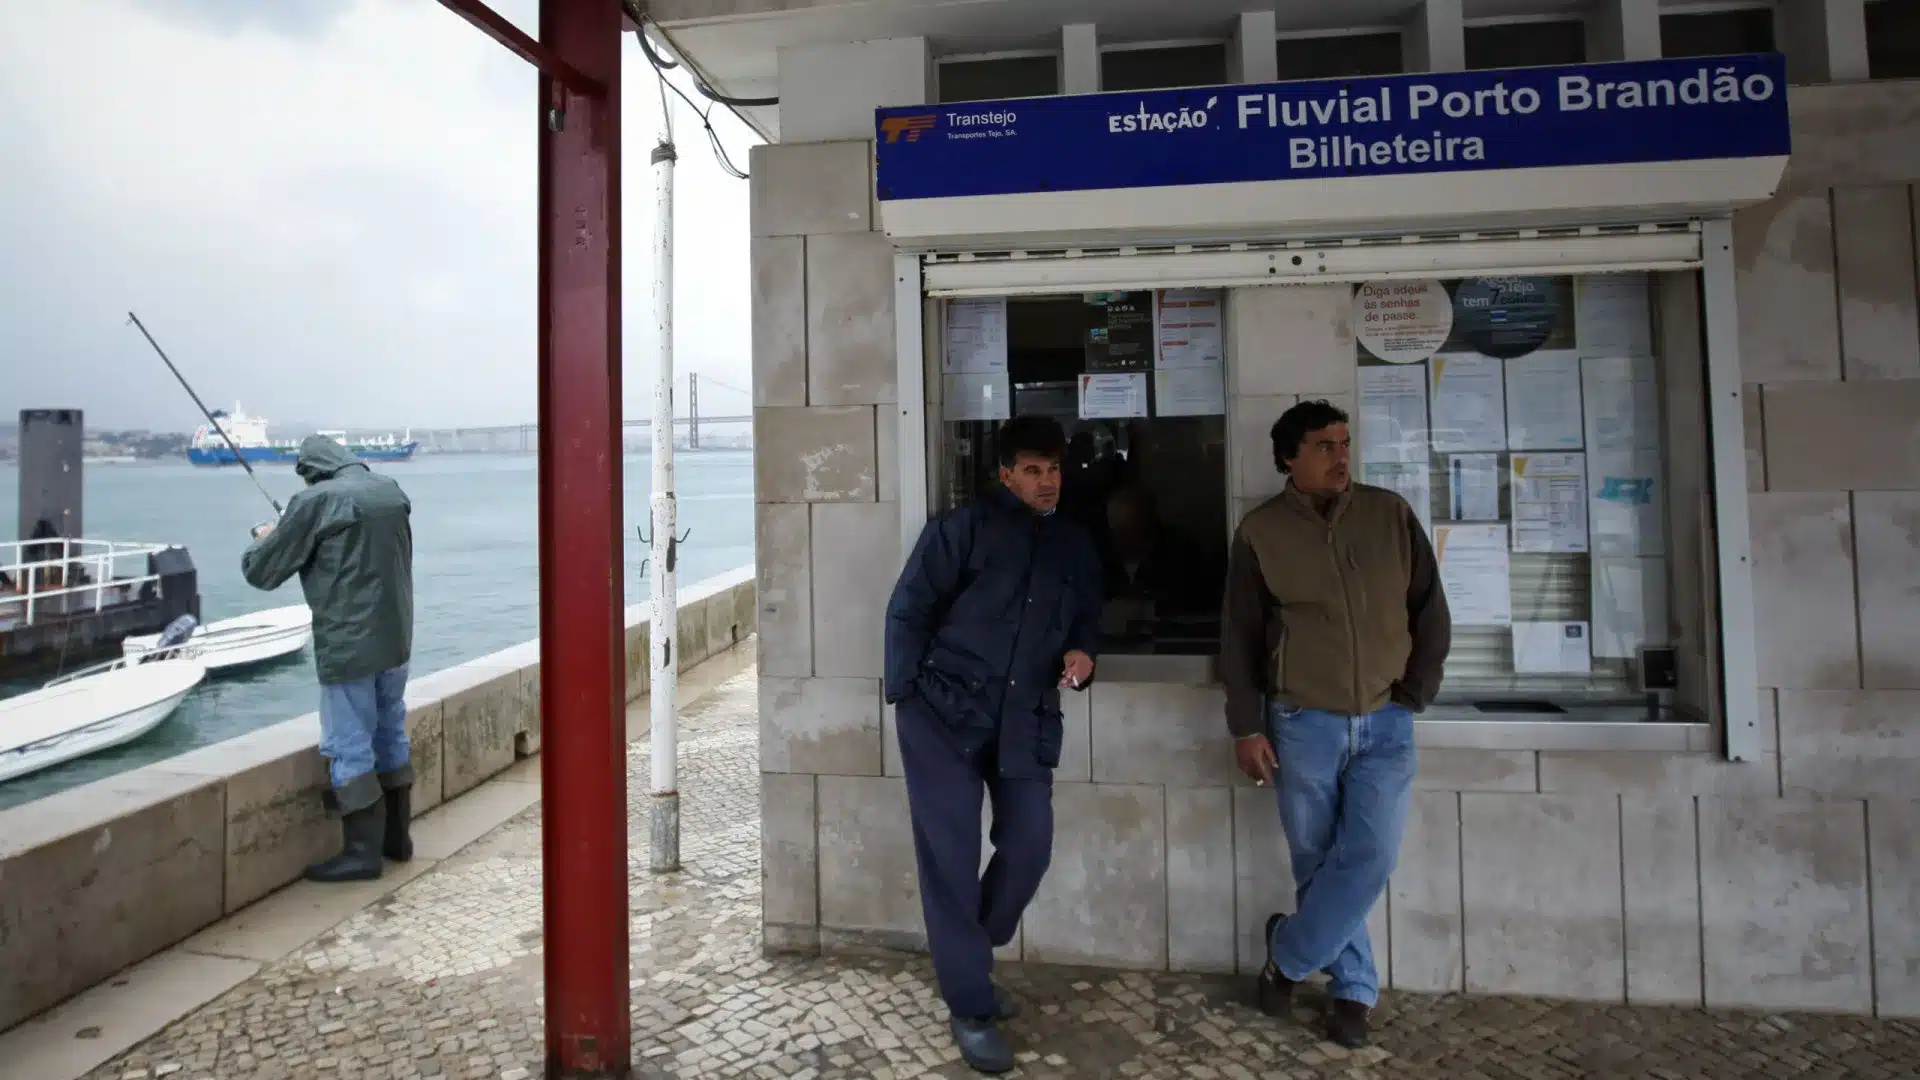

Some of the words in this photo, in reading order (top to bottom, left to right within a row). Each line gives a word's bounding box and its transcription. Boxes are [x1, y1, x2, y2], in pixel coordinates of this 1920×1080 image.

[1109, 100, 1208, 133] ESTAÇÃO
[1237, 87, 1391, 129] Fluvial
[1409, 83, 1541, 120] Porto
[1558, 65, 1774, 112] Brandão
[946, 109, 1017, 127] Transtejo
[947, 131, 987, 140] Transportes
[1289, 131, 1485, 169] Bilheteira
[1363, 286, 1390, 299] Diga
[1393, 284, 1429, 296] adeus
[1380, 297, 1421, 309] senhas
[1463, 296, 1489, 308] tem
[1365, 311, 1379, 322] de
[1383, 311, 1417, 323] passe
